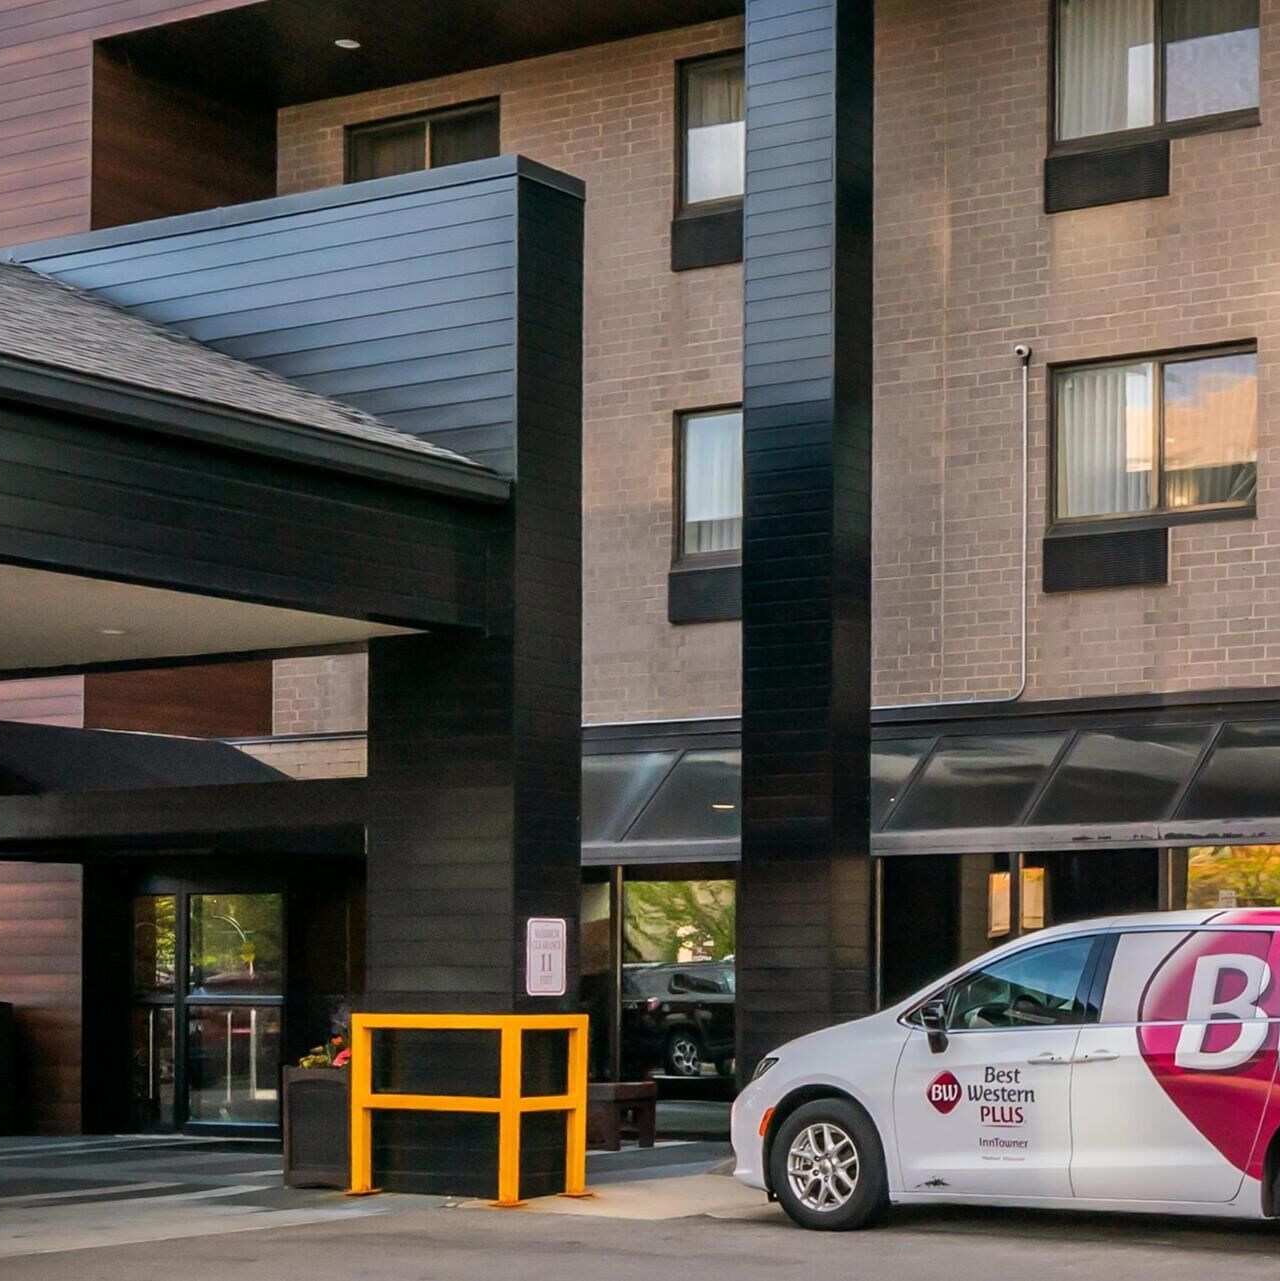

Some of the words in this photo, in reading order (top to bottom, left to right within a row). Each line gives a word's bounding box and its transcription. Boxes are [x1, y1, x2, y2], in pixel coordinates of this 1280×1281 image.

[541, 953, 552, 972] 11
[984, 1066, 1021, 1083] Best
[931, 1084, 958, 1102] BW
[967, 1084, 1035, 1102] Western
[980, 1105, 1024, 1123] PLUS
[979, 1137, 1028, 1149] InnTowner
